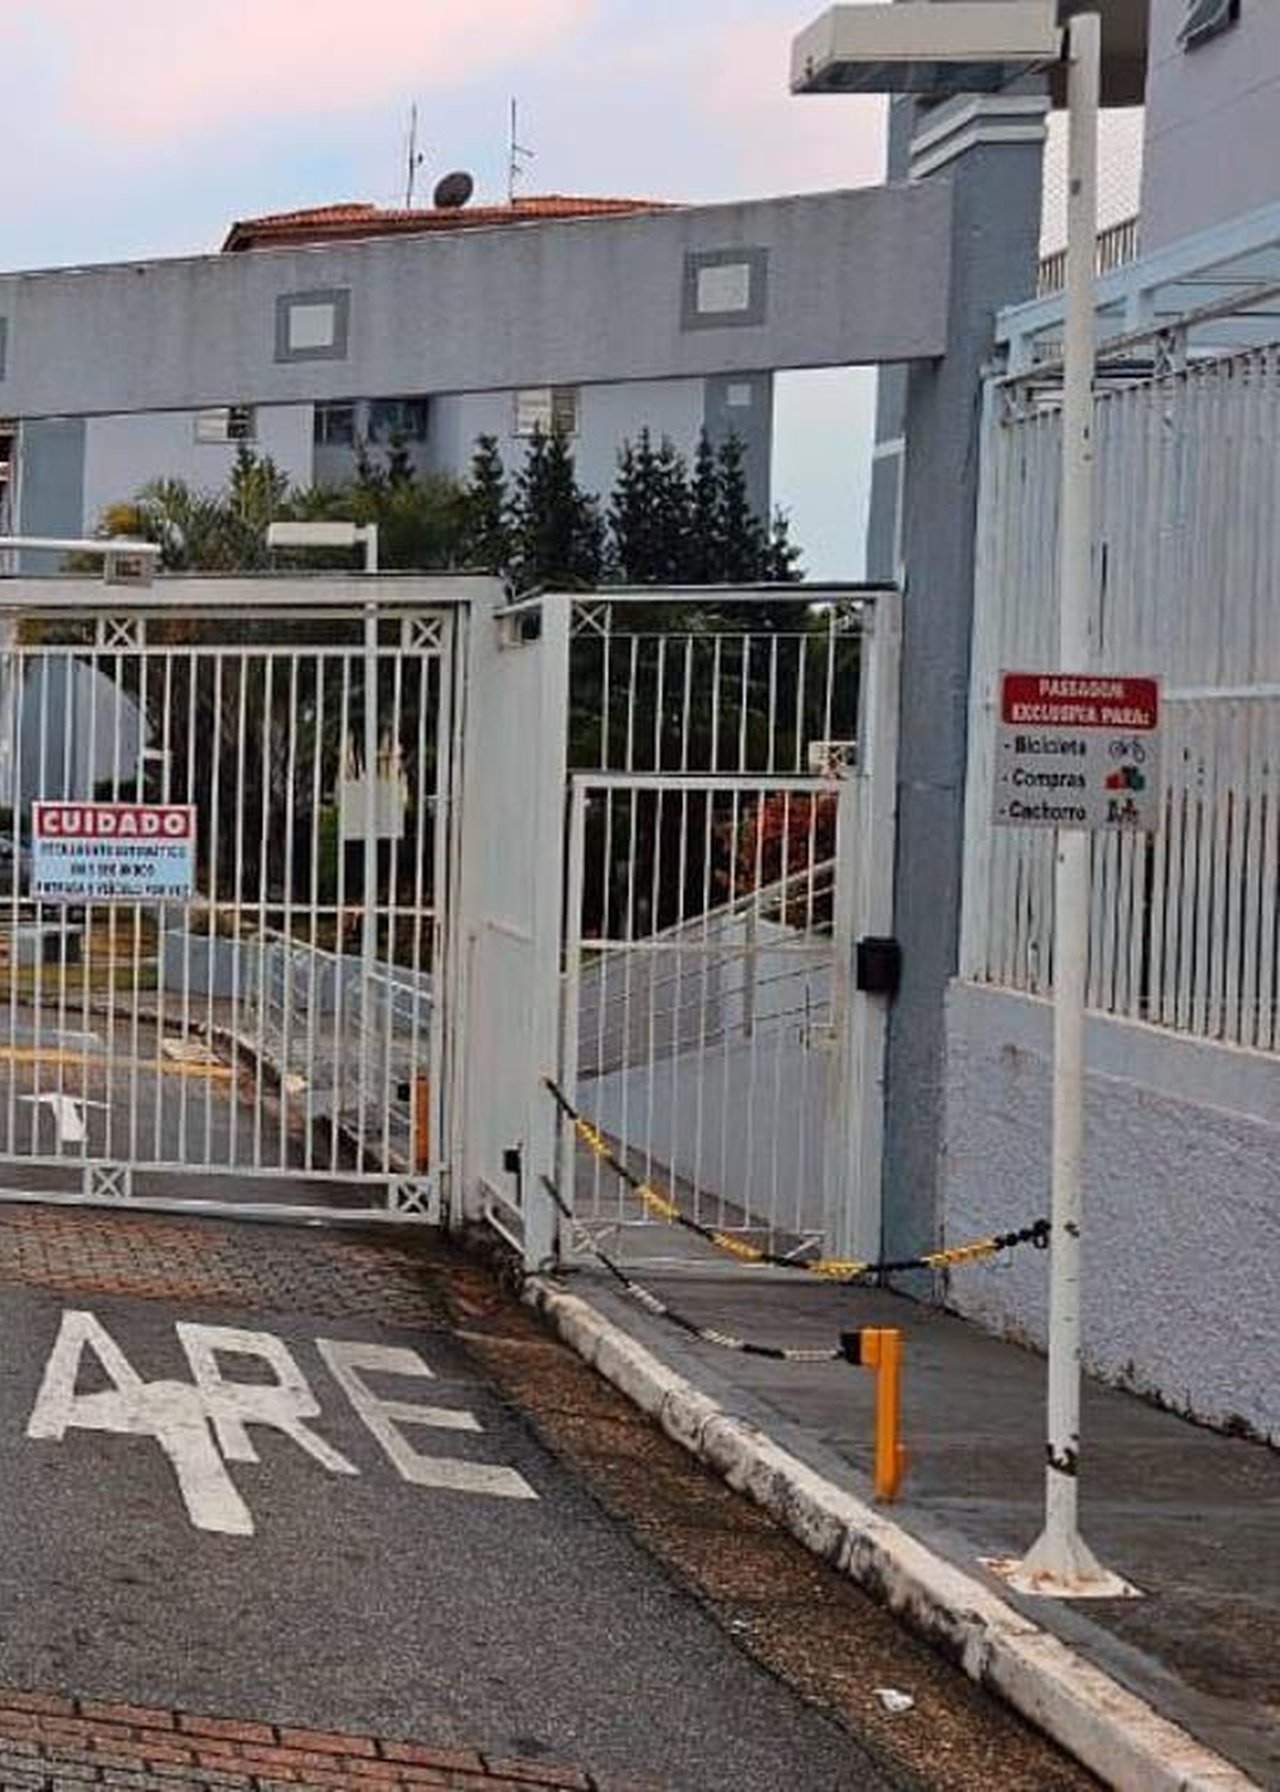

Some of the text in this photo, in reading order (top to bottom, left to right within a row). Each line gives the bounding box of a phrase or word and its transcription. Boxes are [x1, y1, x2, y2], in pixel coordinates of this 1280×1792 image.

[1015, 735, 1087, 755] Bicicleta
[1012, 768, 1087, 791] Compras
[1009, 800, 1087, 821] Cachorro
[42, 809, 188, 835] CUIDADO
